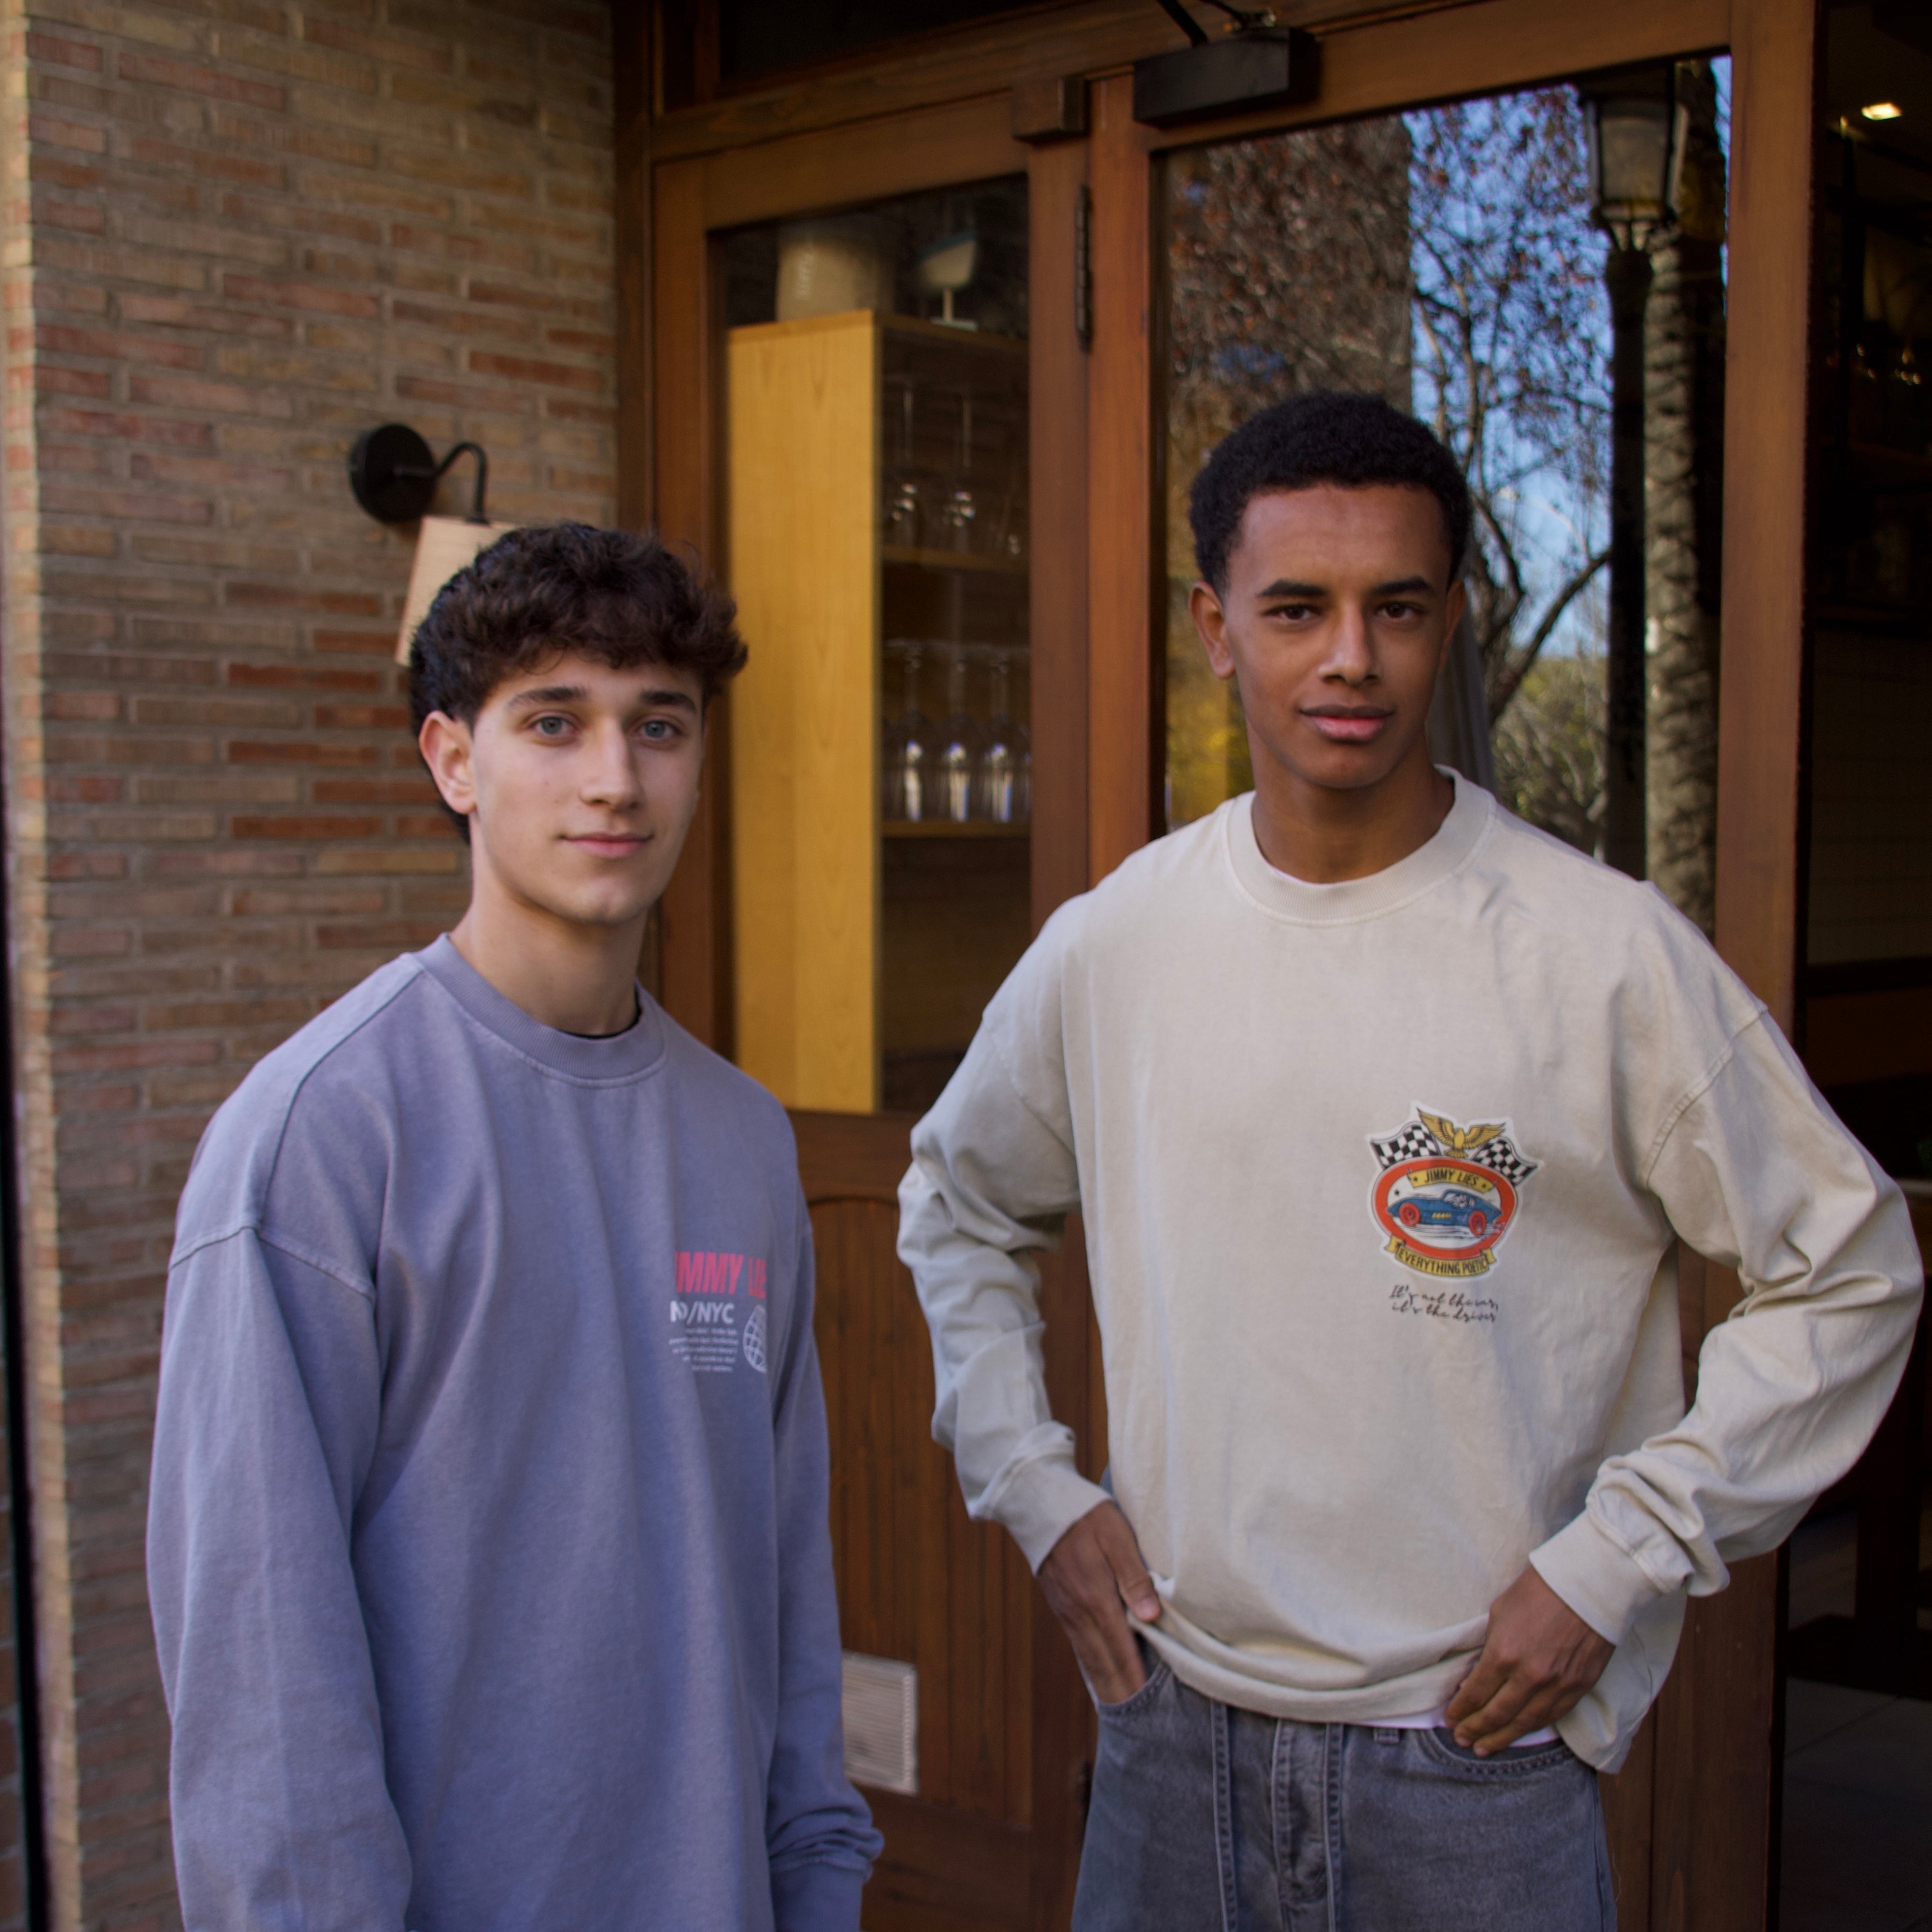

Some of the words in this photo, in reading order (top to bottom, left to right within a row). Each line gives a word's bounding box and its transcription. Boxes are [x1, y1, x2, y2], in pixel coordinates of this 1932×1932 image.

[1425, 1169, 1455, 1183] JIMMY
[1457, 1172, 1479, 1185] LIES
[1398, 1249, 1461, 1274] EVERYTHING
